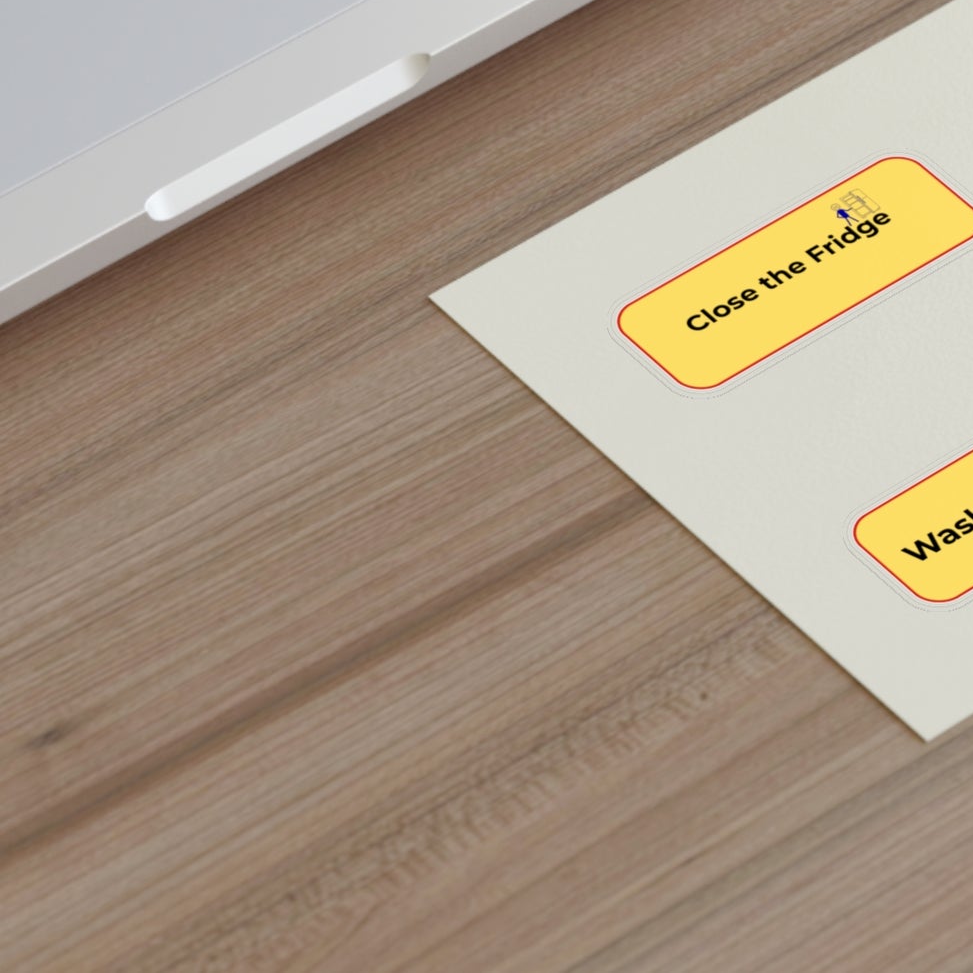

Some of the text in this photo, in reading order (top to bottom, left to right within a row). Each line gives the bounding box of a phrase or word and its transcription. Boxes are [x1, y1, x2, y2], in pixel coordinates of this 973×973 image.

[686, 211, 891, 331] Close the Fridge
